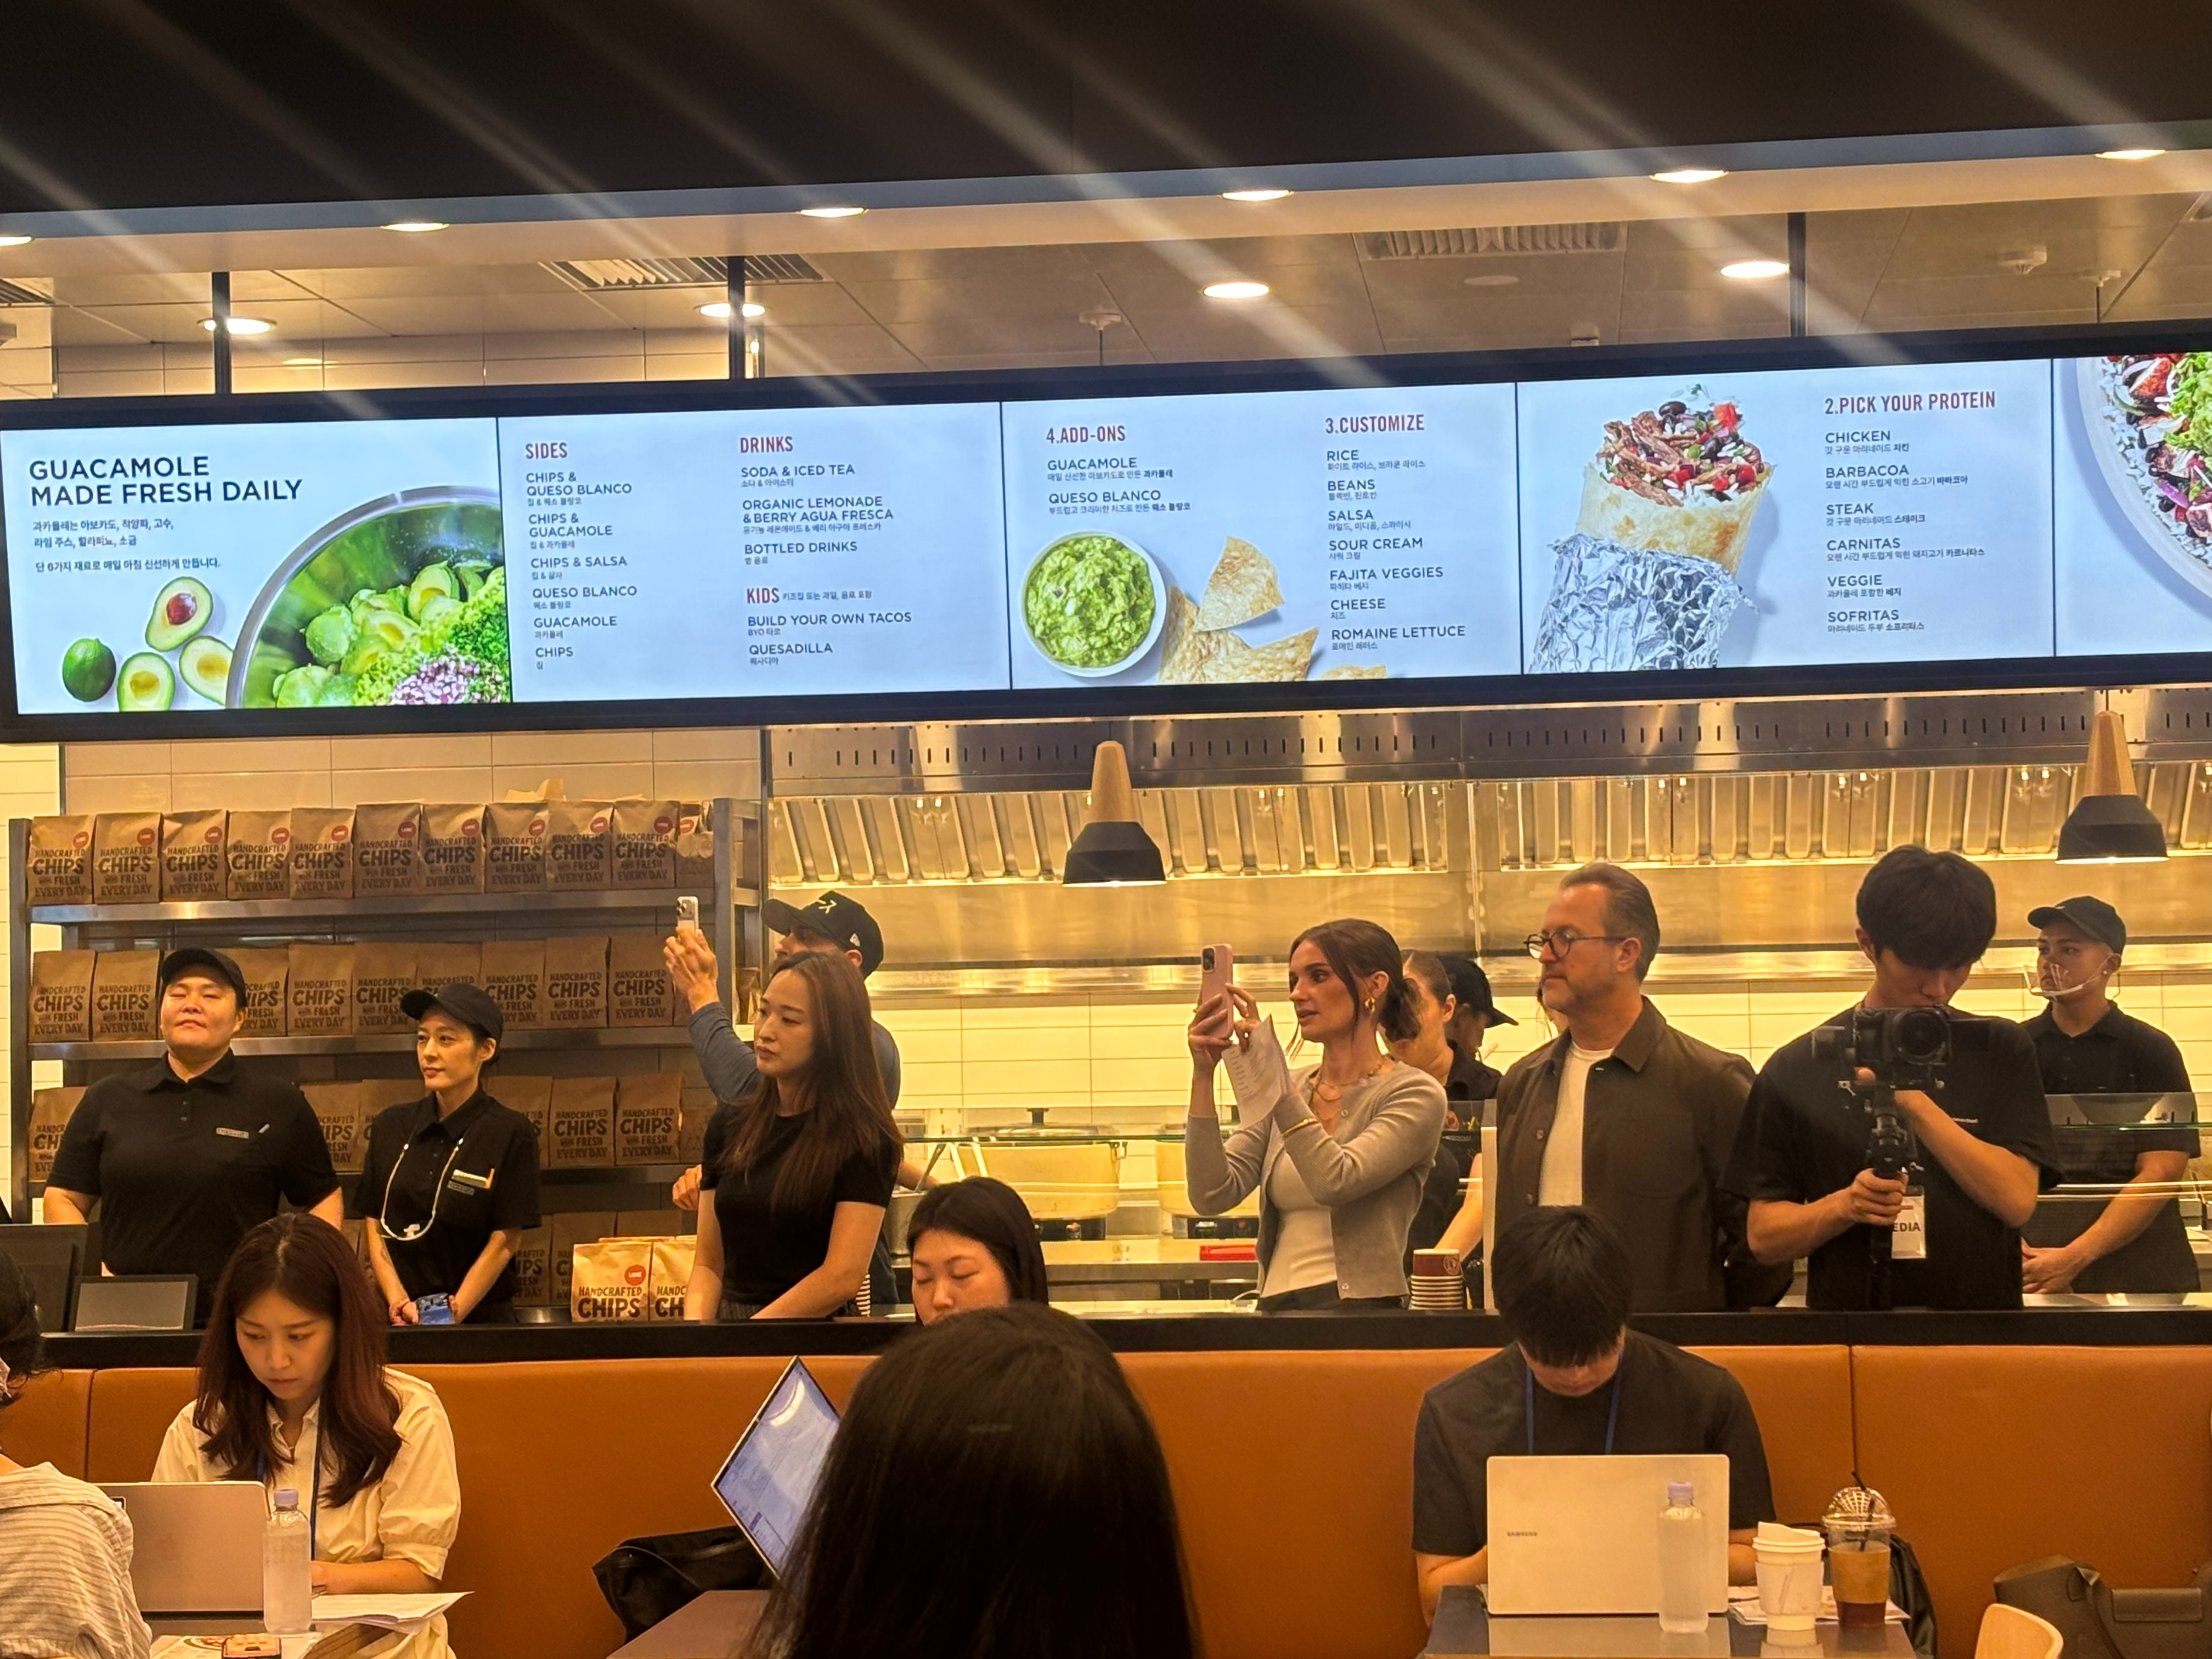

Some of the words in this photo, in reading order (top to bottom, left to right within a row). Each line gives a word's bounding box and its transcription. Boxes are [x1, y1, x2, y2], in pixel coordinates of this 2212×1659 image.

[1825, 396, 1876, 415] 2.PICK
[1881, 394, 1922, 412] YOUR
[1929, 391, 1995, 410] PROTEIN
[1325, 414, 1424, 434] 3.CUSTOMIZE
[1046, 426, 1126, 444] 4.ADD-ONS
[1825, 431, 1891, 443] CHICKEN
[526, 442, 567, 459] SIDES
[740, 436, 793, 453] DRINKS
[1893, 443, 1909, 452] 치킨
[1327, 450, 1359, 461] RICE
[30, 456, 209, 481] GUACAMOLE
[1047, 458, 1137, 471] GUACAMOLE
[526, 472, 564, 483] CHIPS
[568, 472, 577, 482] &
[741, 466, 778, 478] SODA
[782, 466, 790, 476] &
[795, 465, 825, 476] ICED
[828, 465, 855, 475] TEA
[1826, 465, 1909, 478] BARBACOA
[1328, 479, 1375, 491] BEANS
[1843, 480, 1858, 488] 시간
[1912, 476, 1935, 486] 소고기
[31, 485, 112, 506] MADE
[122, 482, 212, 504] FRESH
[223, 479, 303, 501] DAILY
[527, 485, 573, 496] QUESO
[577, 483, 632, 494] BLANCO
[743, 499, 804, 510] ORGANIC
[808, 496, 882, 509] LEMONADE
[1049, 493, 1097, 504] QUESO
[1103, 490, 1161, 502] BLANCO
[1328, 510, 1374, 521] SALSA
[1826, 503, 1874, 515] STEAK
[528, 514, 567, 524] CHIPS
[571, 513, 579, 523] &
[743, 514, 751, 523] &
[754, 512, 797, 523] BERRY
[800, 511, 837, 522] AGUA
[842, 509, 894, 521] FRESCA
[81, 520, 119, 531] 아보카도,
[122, 519, 151, 530] 적양파,
[154, 518, 174, 529] 고수,
[529, 525, 613, 537] GUACAMOLE
[34, 538, 52, 548] 라임
[54, 537, 75, 548] 주스,
[119, 535, 137, 545] 소금
[744, 543, 804, 555] BOTTLED
[809, 541, 857, 552] DRINKS
[1329, 539, 1368, 551] SOUR
[1373, 538, 1423, 549] CREAM
[1827, 538, 1900, 551] CARNITAS
[531, 558, 569, 568] CHIPS
[573, 557, 581, 567] &
[585, 556, 627, 567] SALSA
[1844, 553, 1859, 561] 시간
[36, 562, 44, 572] 단
[48, 561, 71, 572] 6가지
[74, 561, 101, 571] 재료로
[103, 560, 121, 570] 매일
[123, 560, 142, 570] 아침
[145, 558, 179, 569] 신선하게
[1330, 569, 1378, 581] FAJITA
[1381, 567, 1443, 578] VEGGIES
[1827, 574, 1882, 587] VEGGIE
[533, 588, 578, 598] QUESO
[583, 585, 637, 597] BLANCO
[747, 588, 780, 603] KIDS
[1331, 599, 1386, 611] CHEESE
[534, 616, 617, 628] GUACAMOLE
[748, 616, 786, 627] BUILD
[791, 614, 827, 625] YOUR
[831, 613, 864, 624] OWN
[868, 612, 912, 623] TACOS
[1828, 610, 1899, 623] SOFRITAS
[1332, 628, 1398, 640] ROMAINE
[1403, 625, 1465, 637] LETTUCE
[535, 647, 573, 658] CHIPS
[749, 642, 833, 654] QUESADILLA
[360, 839, 412, 849] HANDCRAFTED
[425, 837, 476, 846] HANDCRAFTED
[492, 837, 542, 845] HANDCRAFTED
[552, 834, 604, 842] HANDCRAFTED
[617, 833, 669, 842] HANDCRAFTED
[35, 849, 85, 857] HANDCRAFTED
[100, 847, 152, 856] HANDCRAFTED
[168, 844, 219, 855] HANDCRAFTED
[234, 844, 286, 853] HANDCRAFTED
[295, 843, 346, 851] HANDCRAFTED
[489, 845, 541, 862] CHIPS
[551, 843, 603, 861] CHIPS
[616, 842, 667, 859] CHIPS
[232, 853, 284, 870] CHIPS
[295, 851, 344, 869] CHIPS
[359, 849, 411, 866] CHIPS
[424, 847, 475, 864] CHIPS
[32, 857, 84, 875] CHIPS
[98, 856, 151, 873] CHIPS
[167, 854, 218, 872] CHIPS
[550, 972, 602, 981] HANDCRAFTED
[615, 969, 666, 979] HANDCRAFTED
[99, 985, 151, 994] HANDCRAFTED
[295, 979, 346, 988] HANDCRAFTED
[548, 982, 600, 998] CHIPS
[613, 979, 664, 997] CHIPS
[37, 986, 86, 995] HANDCRAFTED
[292, 988, 345, 1006] CHIPS
[33, 995, 83, 1012] CHIPS
[97, 994, 149, 1011] CHIPS
[556, 1109, 608, 1119] HANDCRAFTED
[622, 1108, 674, 1118] HANDCRAFTED
[554, 1119, 607, 1137] CHIPS
[620, 1117, 672, 1135] CHIPS
[1893, 1222, 1921, 1232] EDIA
[579, 1286, 642, 1296] HANDCRAFTED
[578, 1297, 641, 1318] CHIPS
